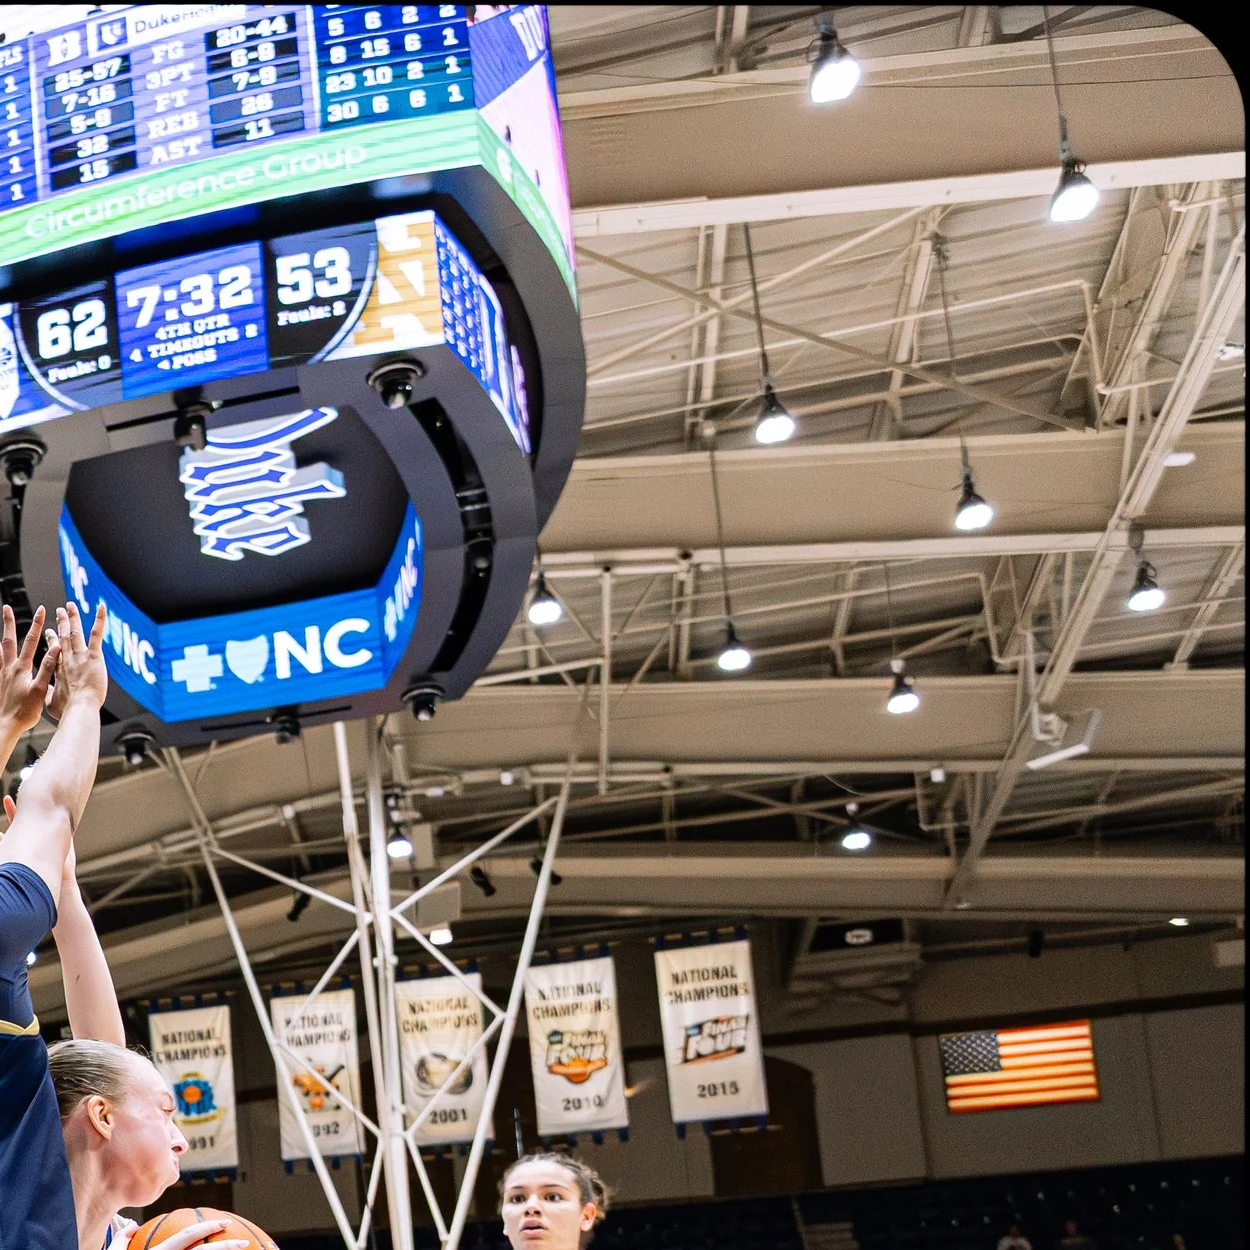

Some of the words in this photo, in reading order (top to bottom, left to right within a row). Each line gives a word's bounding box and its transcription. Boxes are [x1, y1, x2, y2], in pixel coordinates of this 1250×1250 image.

[328, 18, 344, 36] 5
[365, 11, 382, 29] 6
[402, 6, 418, 24] 2
[55, 58, 121, 92] 25-57
[151, 40, 185, 65] FG
[216, 15, 288, 49] 20-44
[361, 38, 390, 58] 15
[442, 27, 459, 46] 1
[145, 61, 196, 90] 3PT
[363, 66, 392, 86] 10
[445, 56, 461, 73] 1
[4, 76, 18, 93] 1
[6, 102, 20, 120] 1
[154, 88, 190, 113] FT
[328, 101, 358, 122] 30
[448, 84, 463, 102] 1
[7, 129, 21, 147] 1
[146, 110, 200, 141] REB
[79, 159, 109, 182] 15
[149, 135, 203, 166] AST
[245, 118, 275, 141] 11
[9, 156, 23, 174] 1
[10, 184, 25, 201] 1
[25, 163, 256, 238] Circumference
[262, 145, 368, 181] Group
[275, 246, 353, 306] 53
[126, 265, 254, 329] 7:32
[155, 321, 192, 341] 4TH
[194, 313, 231, 334] QTR
[277, 304, 331, 326] Fouls:
[37, 299, 109, 360] 62
[130, 348, 143, 362] 4
[147, 328, 240, 359] TIMEOUTS
[48, 358, 97, 384] Fouls:
[172, 348, 218, 369] POSS
[122, 622, 157, 685] NC
[273, 617, 373, 680] NC
[670, 964, 738, 985] NATIONAL
[667, 981, 749, 1005] CHAMPIONS
[284, 1012, 344, 1028] NTIONAL
[285, 1029, 351, 1048] HAMPIONS
[697, 1080, 740, 1098] 2015
[561, 1094, 603, 1111] 2010
[311, 1120, 340, 1137] 992
[429, 1107, 469, 1125] 2001
[189, 1136, 215, 1151] 991
